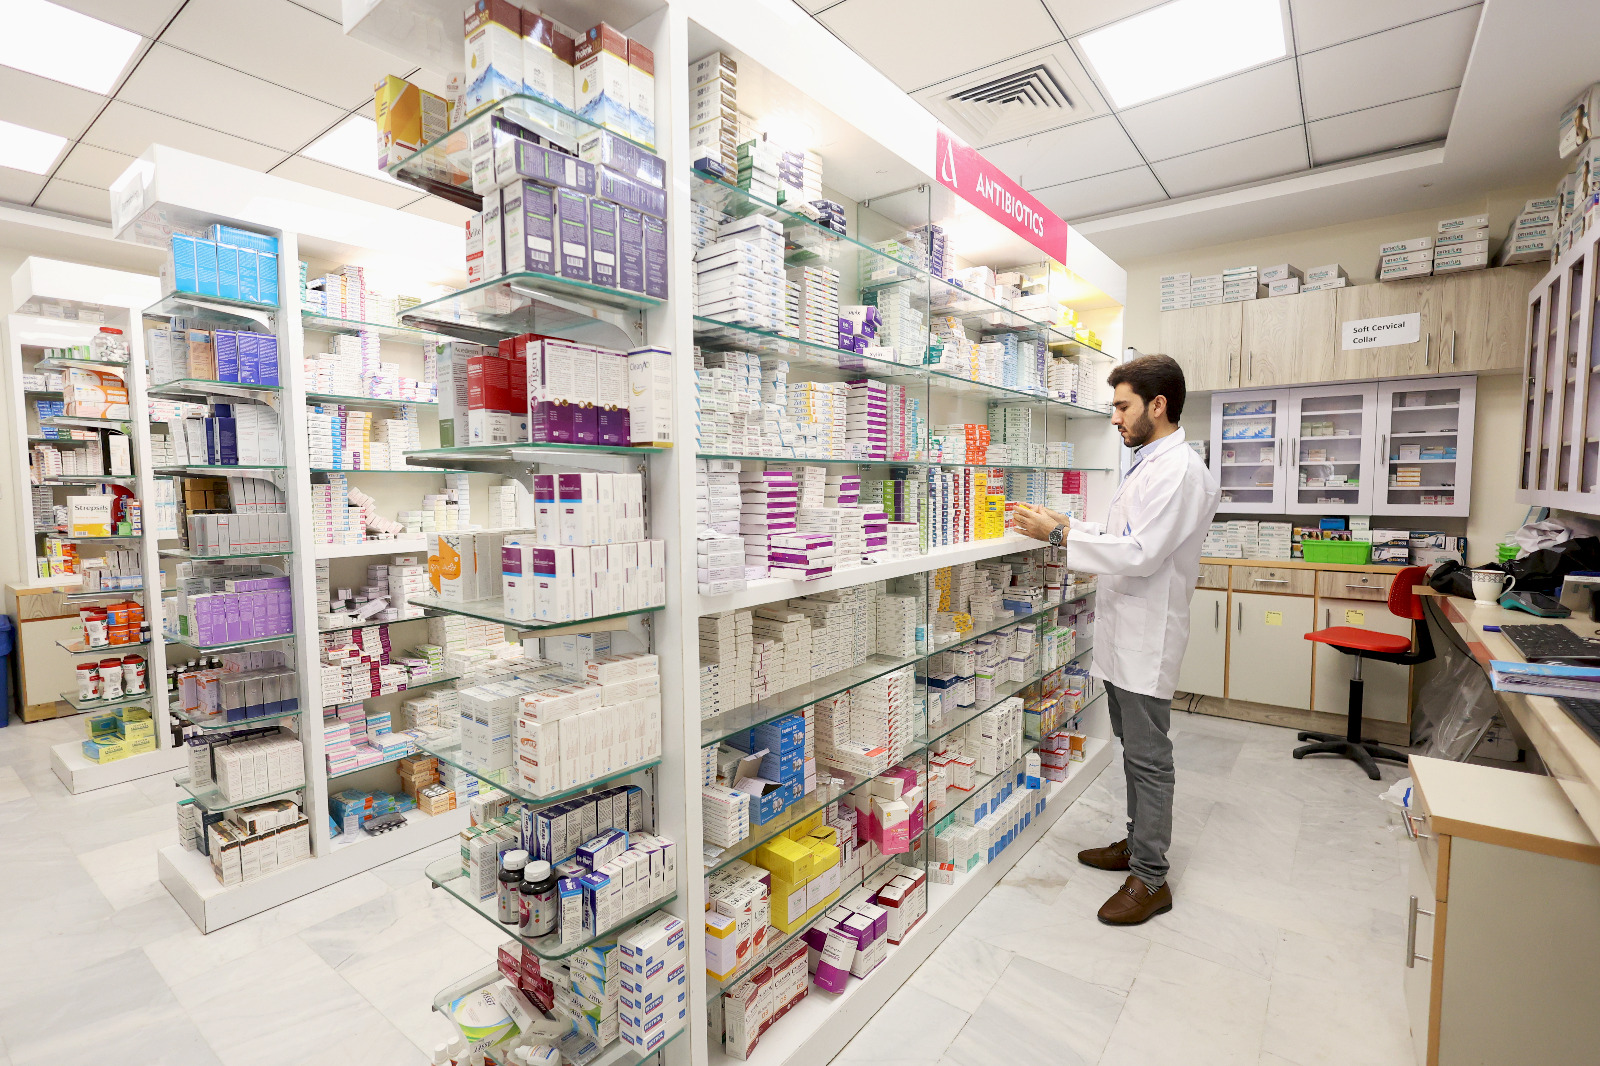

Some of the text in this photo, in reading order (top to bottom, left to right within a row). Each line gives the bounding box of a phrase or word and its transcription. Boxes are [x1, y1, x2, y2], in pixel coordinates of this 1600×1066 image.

[976, 172, 1044, 237] ANTIBIOTICS
[1372, 321, 1405, 331] Cervical
[530, 353, 539, 394] Vigen
